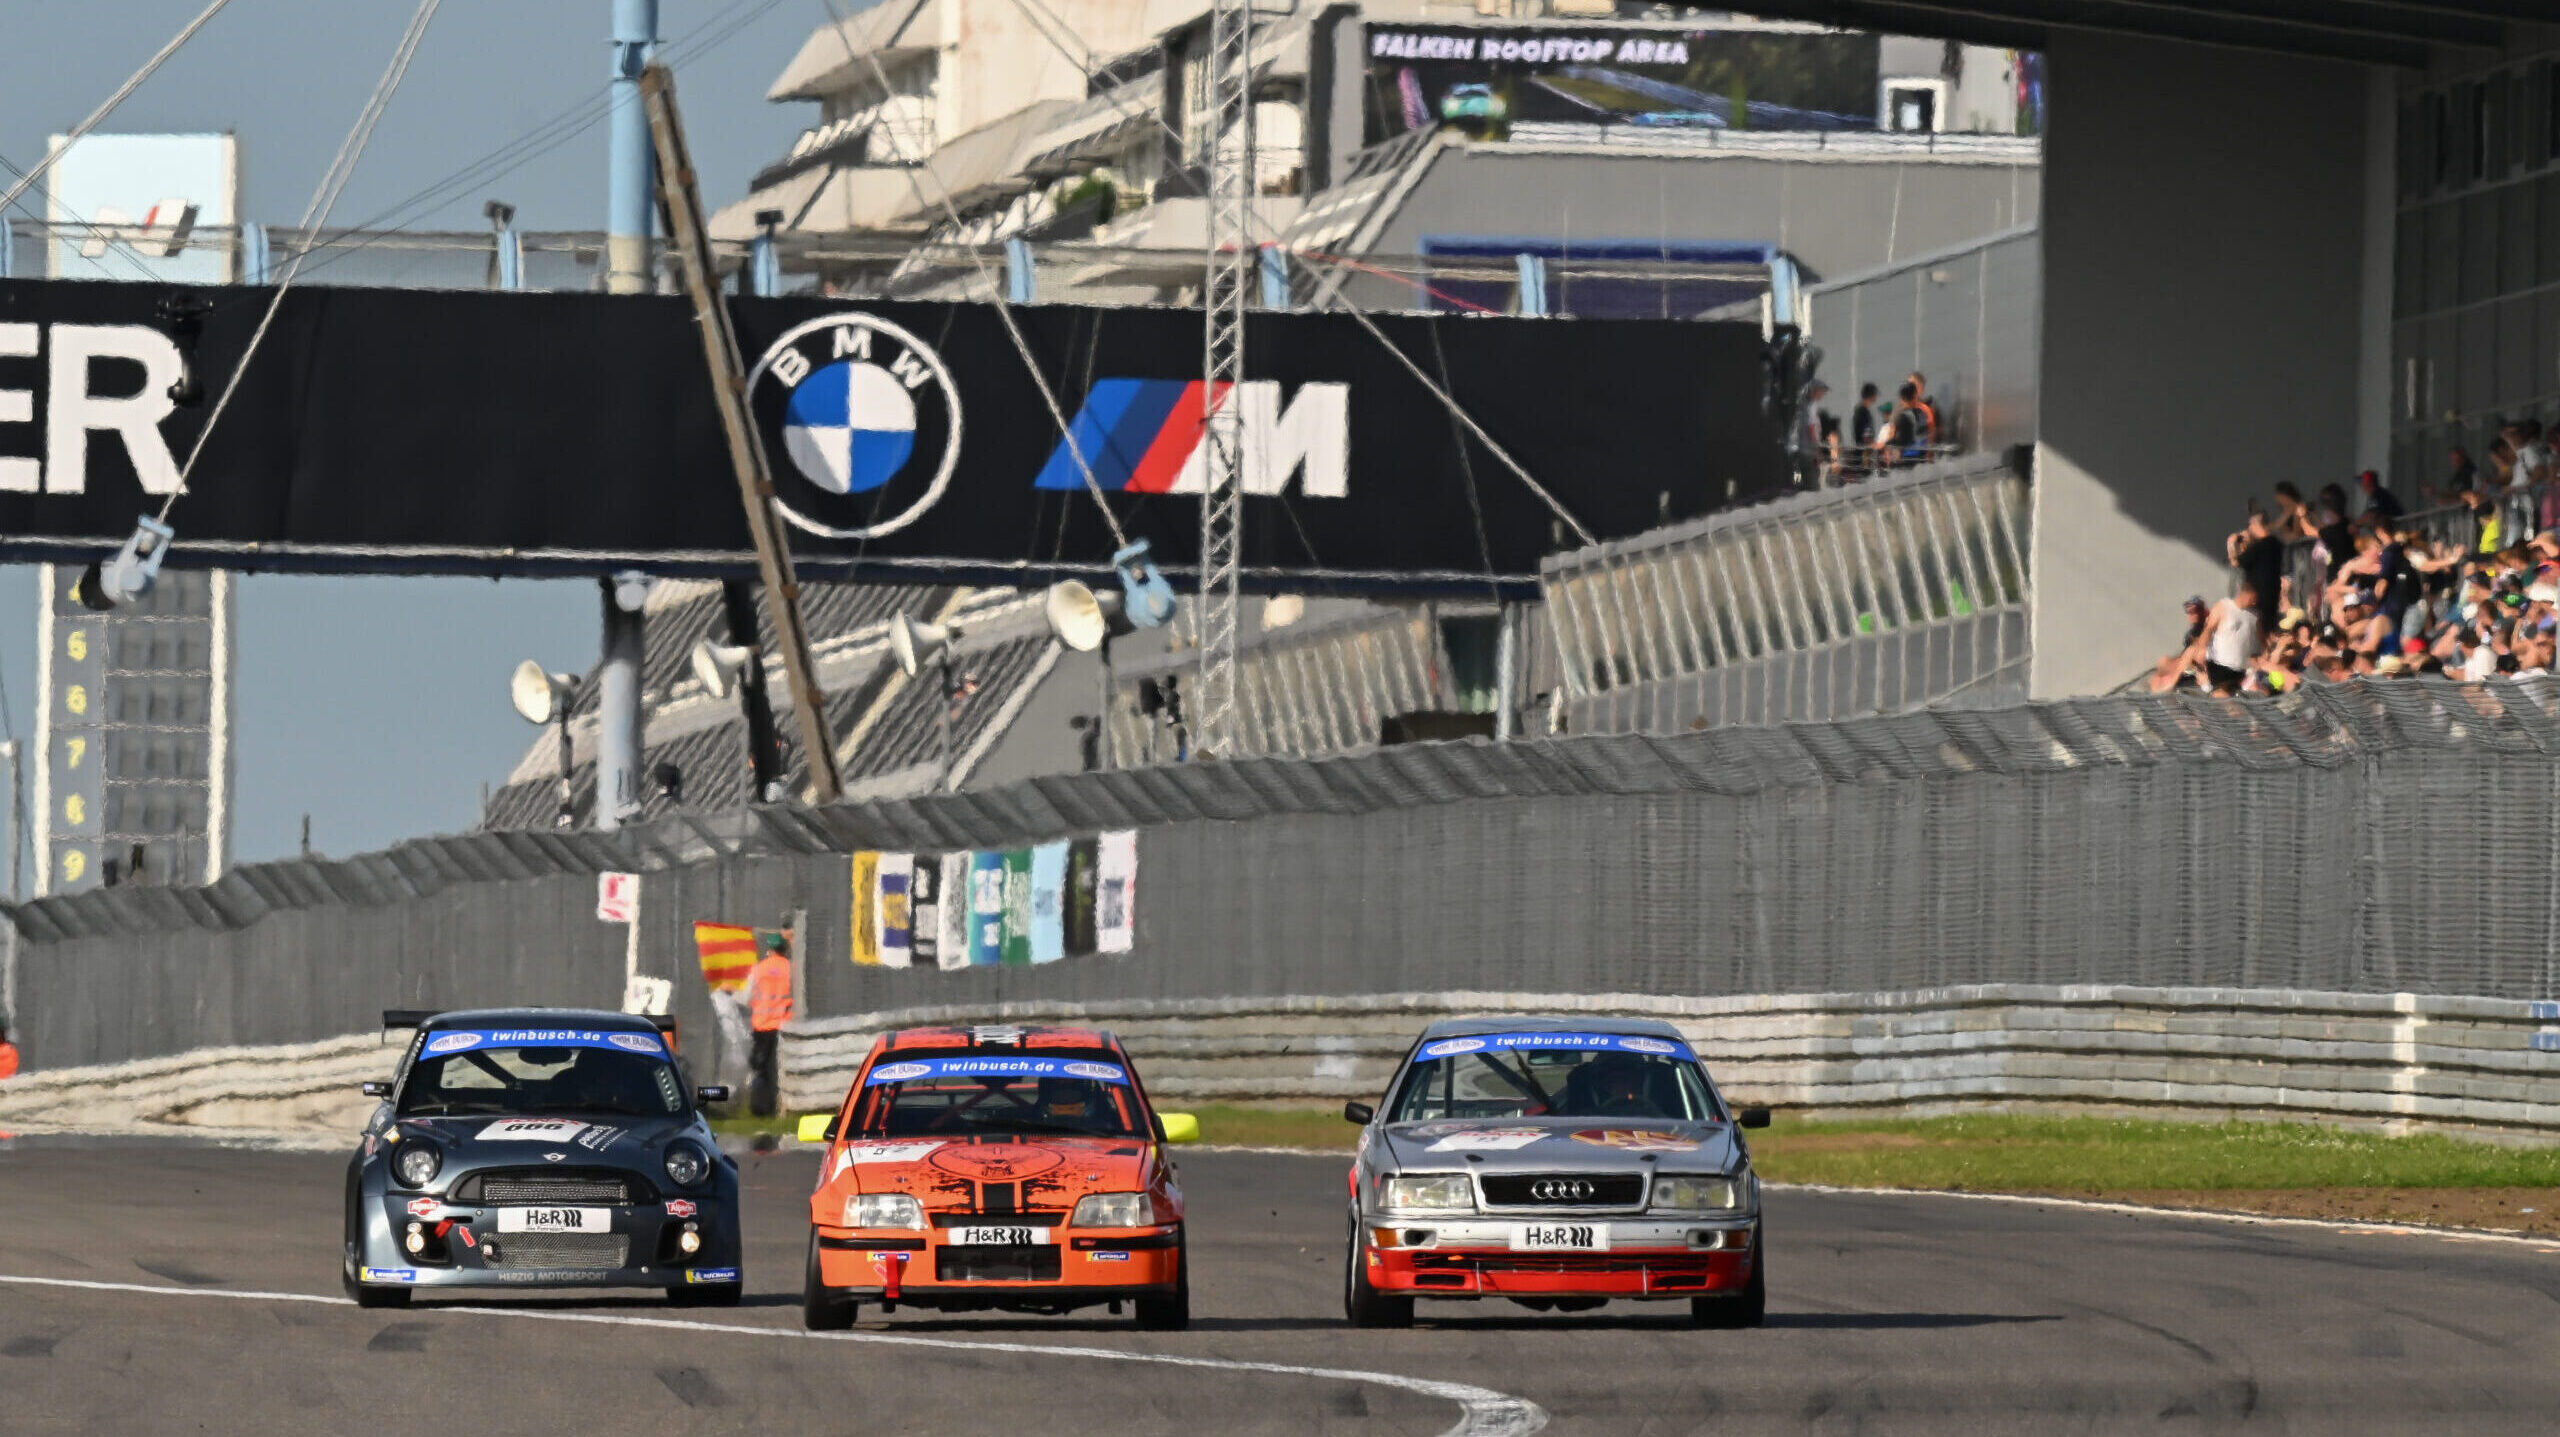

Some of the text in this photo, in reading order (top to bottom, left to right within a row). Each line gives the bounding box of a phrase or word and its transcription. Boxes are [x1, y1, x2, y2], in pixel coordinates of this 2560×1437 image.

[1373, 33, 1690, 64] FALKEN ROOFTOP AREA
[770, 325, 933, 388] BMW
[66, 736, 86, 769] 7
[63, 850, 86, 883] 9
[491, 1031, 601, 1042] twinbusch.de
[1496, 1036, 1609, 1047] twinbusch.de
[941, 1061, 1056, 1073] twinbusch.de
[504, 1123, 564, 1132] 666
[526, 1209, 563, 1225] H&R
[965, 1228, 1006, 1242] H&R
[1526, 1226, 1568, 1245] H&R
[538, 1271, 608, 1281] MOTORSPORT
